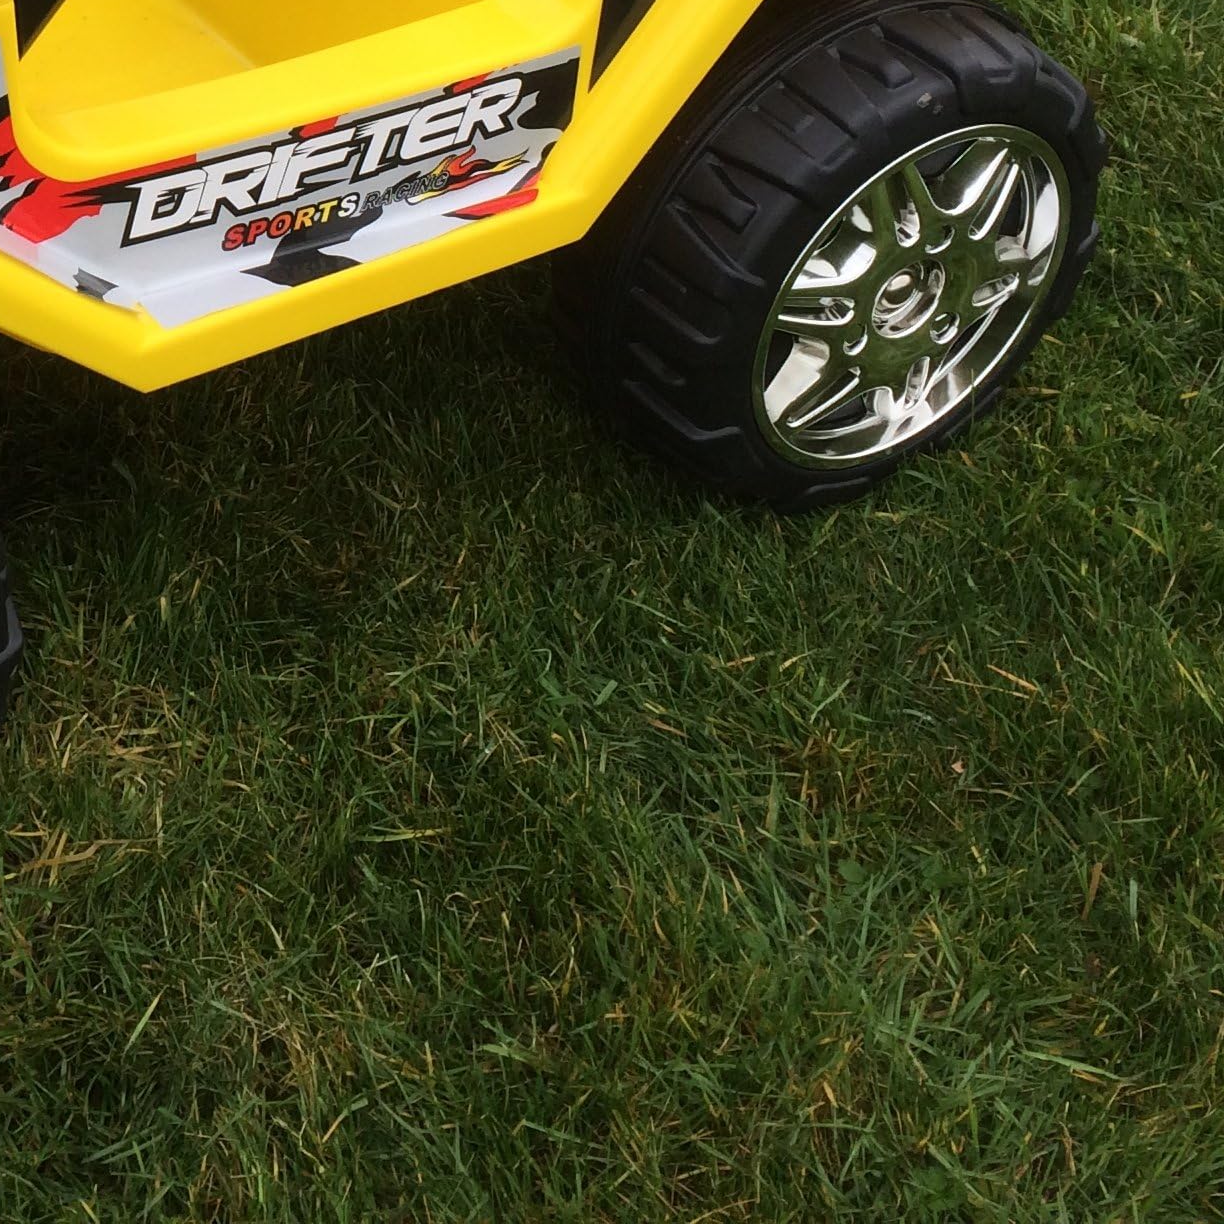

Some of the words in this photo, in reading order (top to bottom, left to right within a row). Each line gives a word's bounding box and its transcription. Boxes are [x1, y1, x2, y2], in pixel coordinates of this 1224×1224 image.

[119, 76, 524, 248] DRIFTER
[222, 190, 361, 251] SPORTS
[361, 170, 450, 211] RACING
